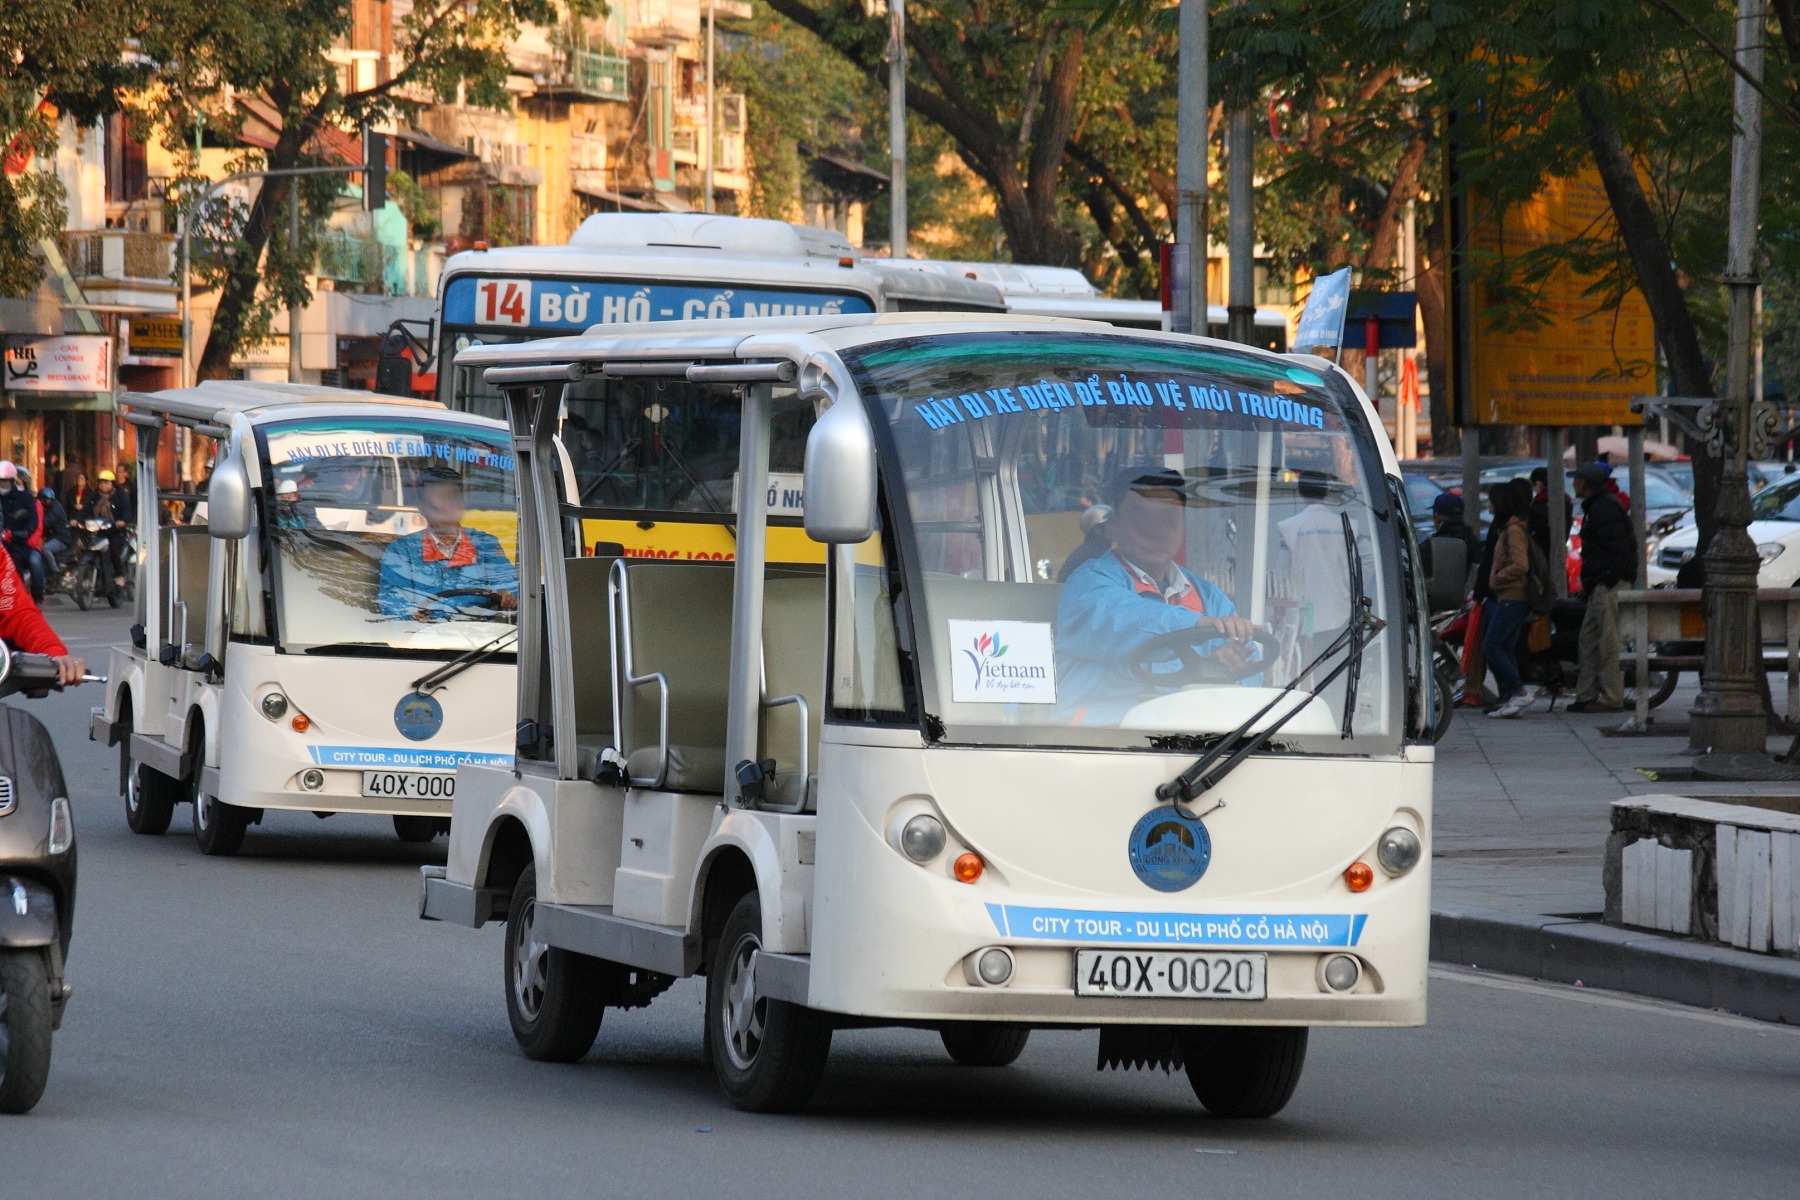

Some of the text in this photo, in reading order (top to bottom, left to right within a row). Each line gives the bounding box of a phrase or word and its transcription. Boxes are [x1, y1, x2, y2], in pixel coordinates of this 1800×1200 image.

[481, 282, 525, 324] 14
[539, 285, 591, 323] BỜ
[602, 287, 651, 324] HỒ
[660, 308, 674, 316] -
[683, 290, 734, 320] CỔ
[914, 373, 1323, 430] HÃY ĐI XE ĐIỆN ĐỂ BẢO VỆ MÔI TRƯỜNG
[315, 444, 331, 458] ĐI
[332, 442, 351, 457] XE
[455, 446, 480, 464] MÔI
[962, 649, 1046, 691] Vietnam
[333, 752, 355, 762] CITY
[358, 753, 385, 762] TOUR
[394, 754, 408, 763] DU
[410, 754, 432, 766] LỊCH
[434, 754, 455, 765] PHỐ
[370, 774, 455, 797] 40X-000
[1032, 917, 1071, 934] CITY
[1075, 918, 1122, 936] TOUR
[1136, 921, 1159, 937] DU
[1165, 921, 1201, 941] LỊCH
[1206, 917, 1242, 938] PHỐ
[1245, 916, 1270, 939] CỔ
[1274, 919, 1298, 939] HÀ
[1301, 920, 1329, 943] NỘI
